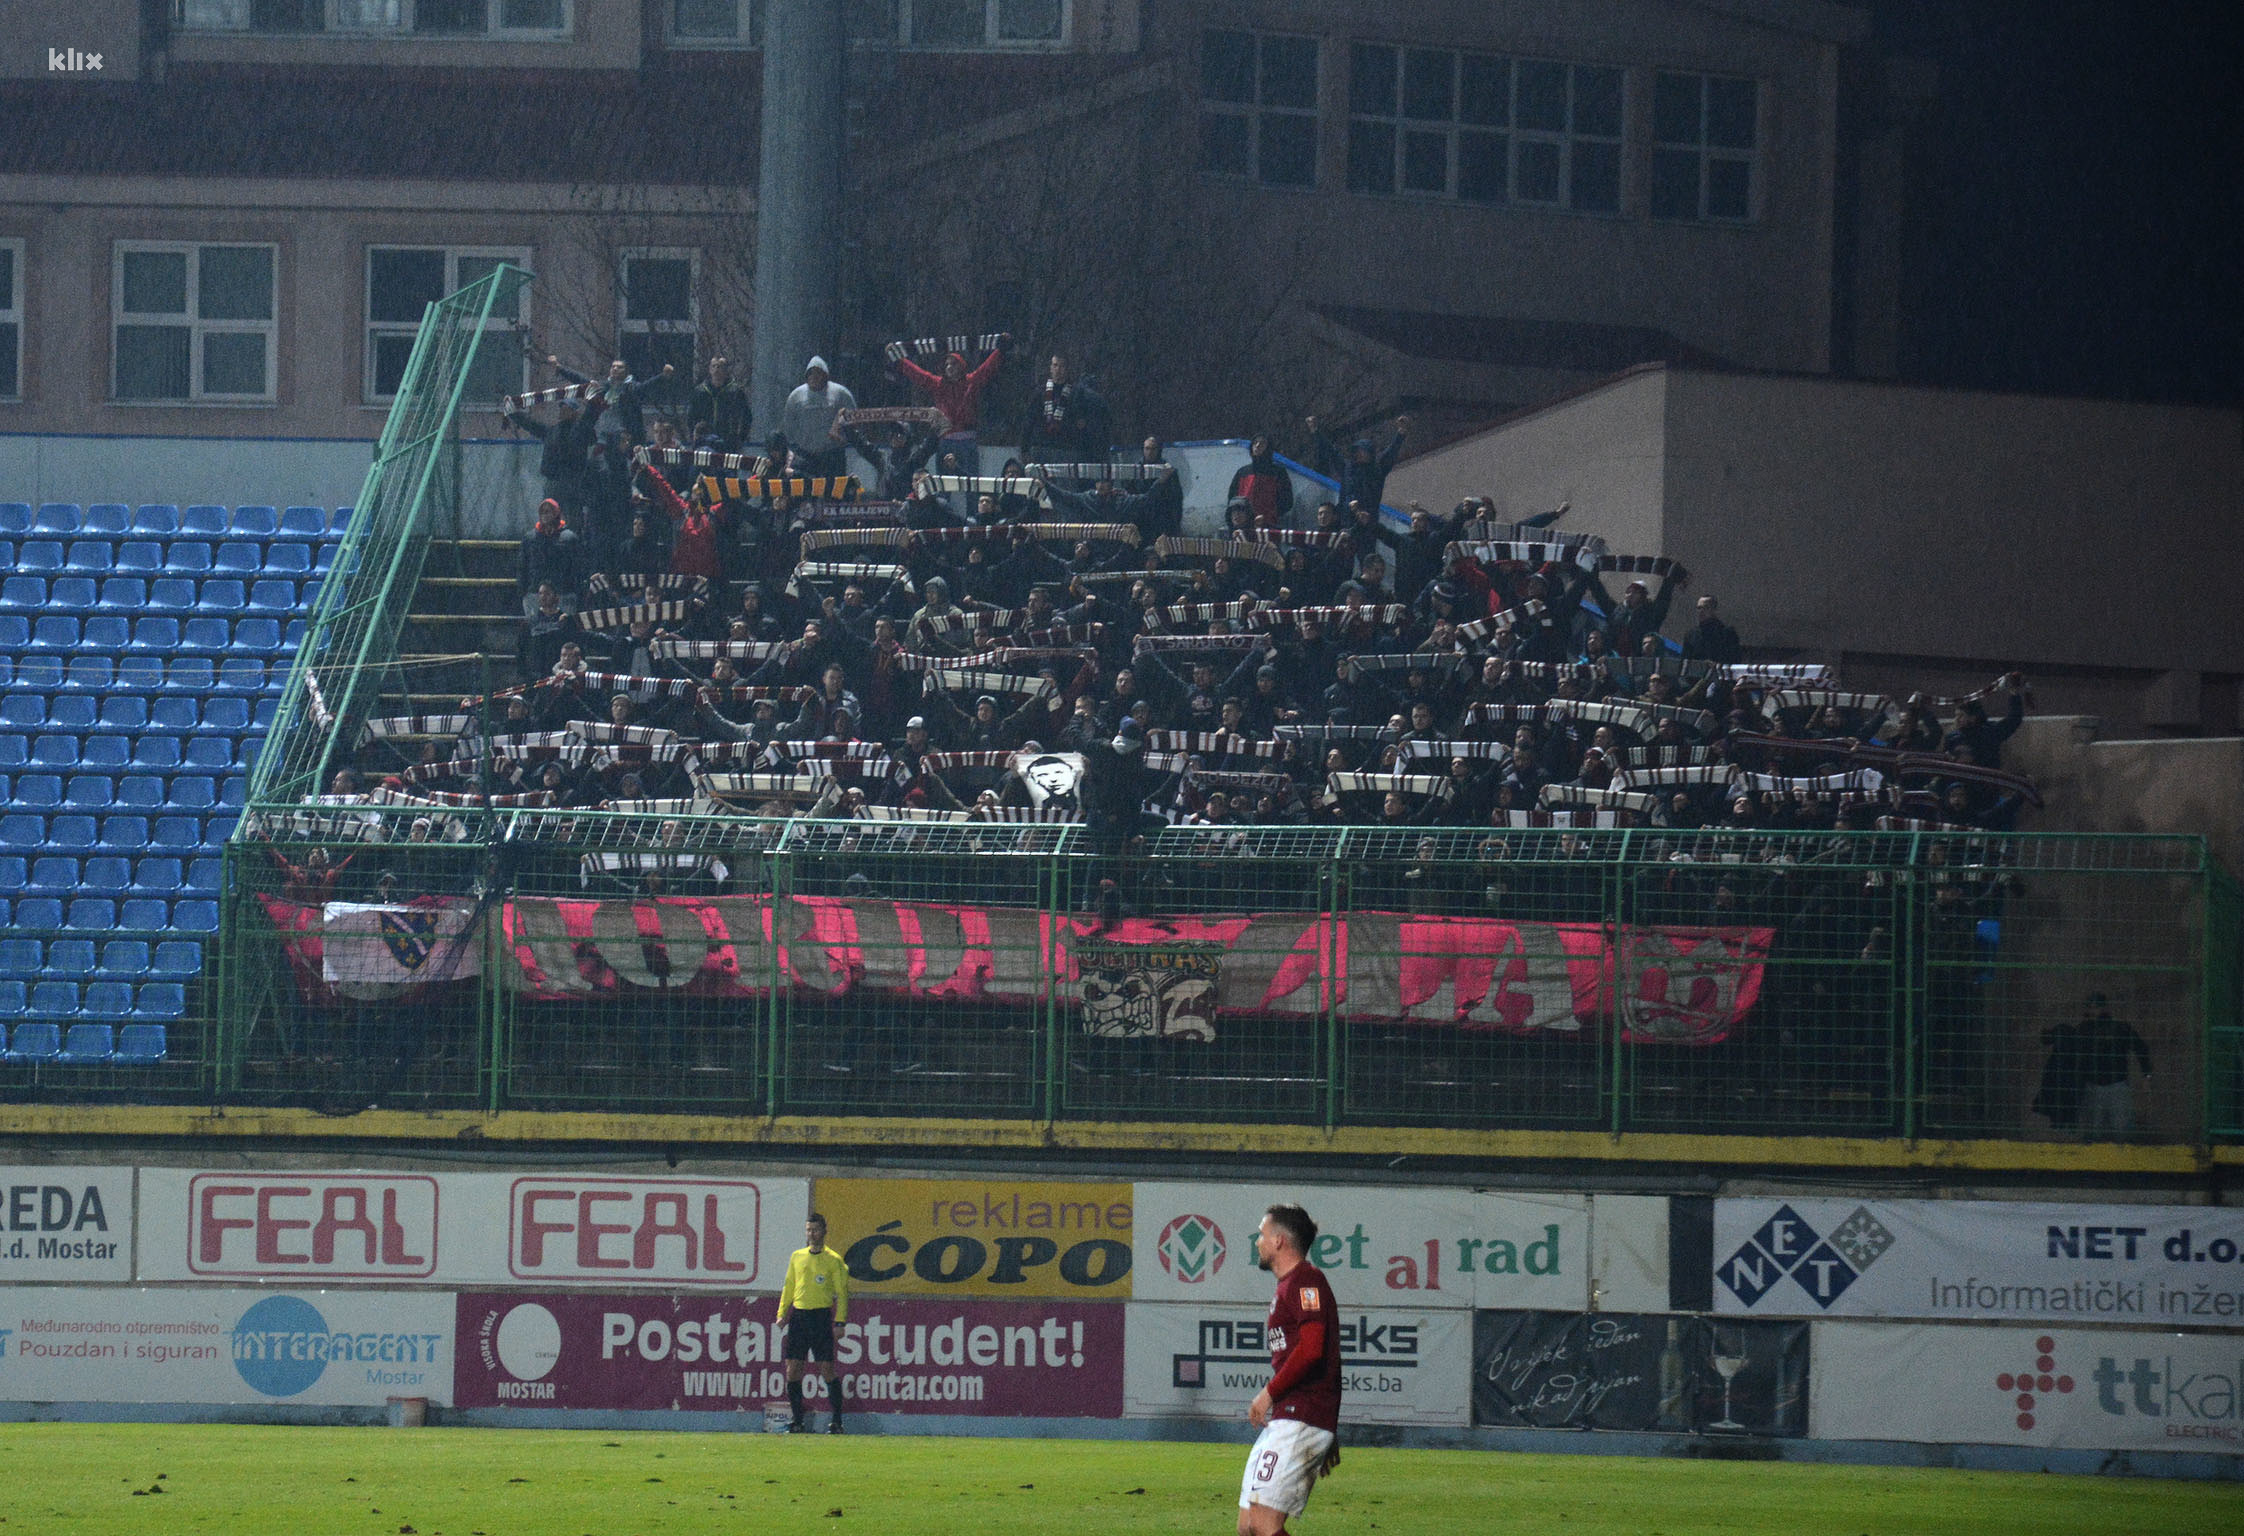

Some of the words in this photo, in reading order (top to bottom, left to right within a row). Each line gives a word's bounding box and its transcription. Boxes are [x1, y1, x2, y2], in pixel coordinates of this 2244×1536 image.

[0, 1185, 109, 1232] EDA
[200, 1186, 425, 1266] FEAL
[930, 1192, 1134, 1231] reklame
[37, 1238, 118, 1260] Mostar
[520, 1190, 746, 1272] FEAL
[2047, 1225, 2147, 1261] NET
[1247, 1223, 1370, 1270] et
[1456, 1223, 1562, 1276] rad
[1929, 1276, 2145, 1314] Informatički
[21, 1319, 121, 1334] Međunarodno
[126, 1320, 220, 1337] otpremništvo
[602, 1312, 815, 1363] Posta
[837, 1314, 1085, 1369] student!
[19, 1340, 115, 1359] Pouzdan
[123, 1340, 129, 1359] i
[135, 1341, 218, 1363] siguran
[222, 1330, 441, 1363] INTERAGENT
[366, 1368, 425, 1385] Mostar
[497, 1381, 556, 1400] MOSTAR
[683, 1368, 984, 1401] www.looscentar.com
